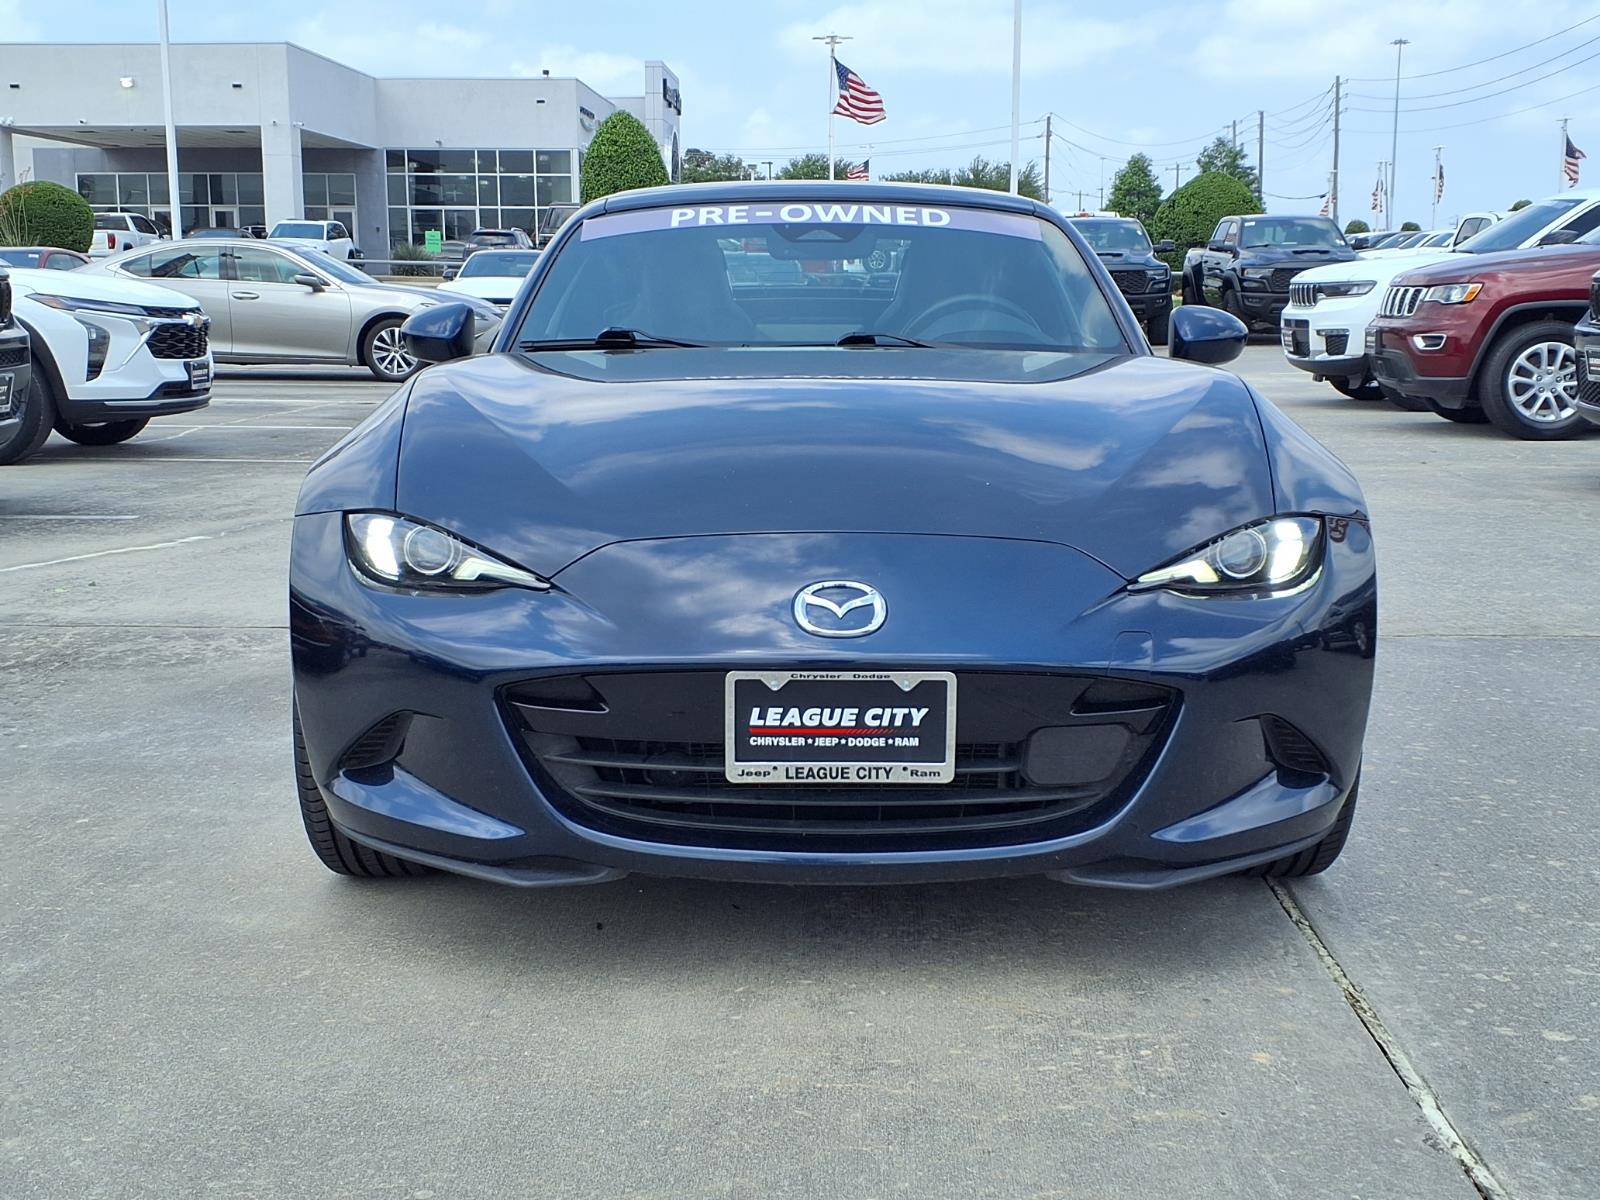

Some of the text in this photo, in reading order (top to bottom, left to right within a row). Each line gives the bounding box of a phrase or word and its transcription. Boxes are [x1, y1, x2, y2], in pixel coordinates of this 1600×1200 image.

[671, 204, 951, 227] PRE-OWNED
[750, 707, 929, 727] LEAGUE CITY
[750, 737, 919, 746] CHRYSLER JEEP DODGE RAM
[737, 767, 941, 780] Jeep LEAGUE CITY Ram
